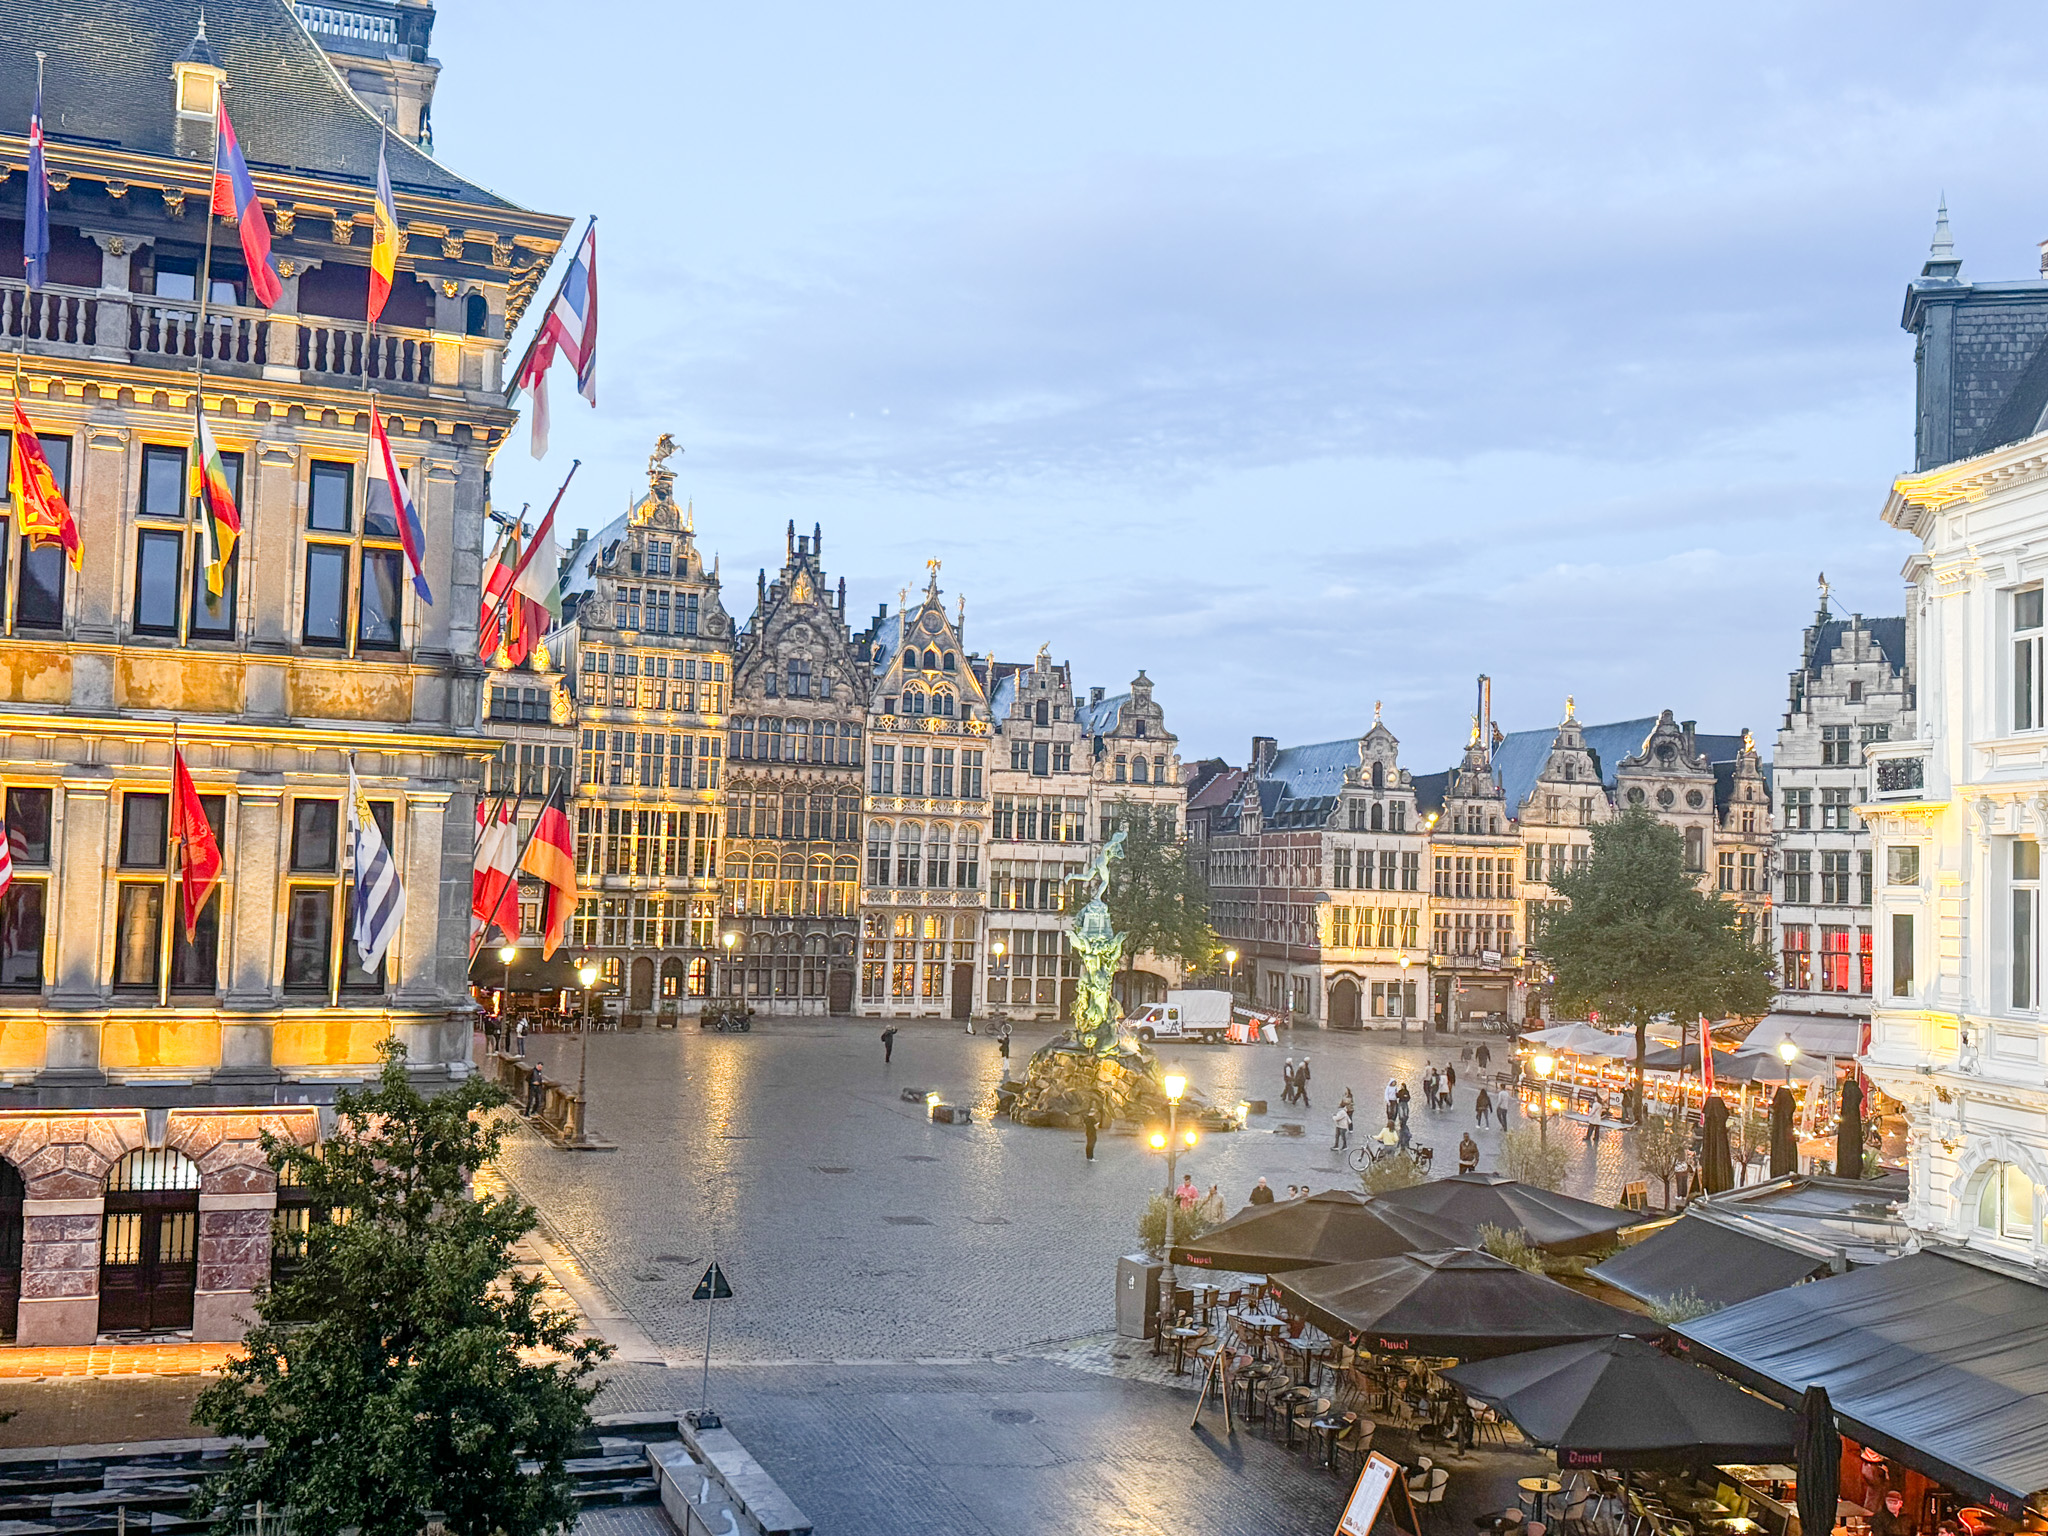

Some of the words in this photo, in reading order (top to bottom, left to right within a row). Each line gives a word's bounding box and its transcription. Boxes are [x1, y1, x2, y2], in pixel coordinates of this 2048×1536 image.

[1186, 1253, 1212, 1265] Duvel
[1380, 1338, 1409, 1350] Duvel
[1569, 1451, 1603, 1464] Duvel
[1989, 1492, 2009, 1512] Duvel
